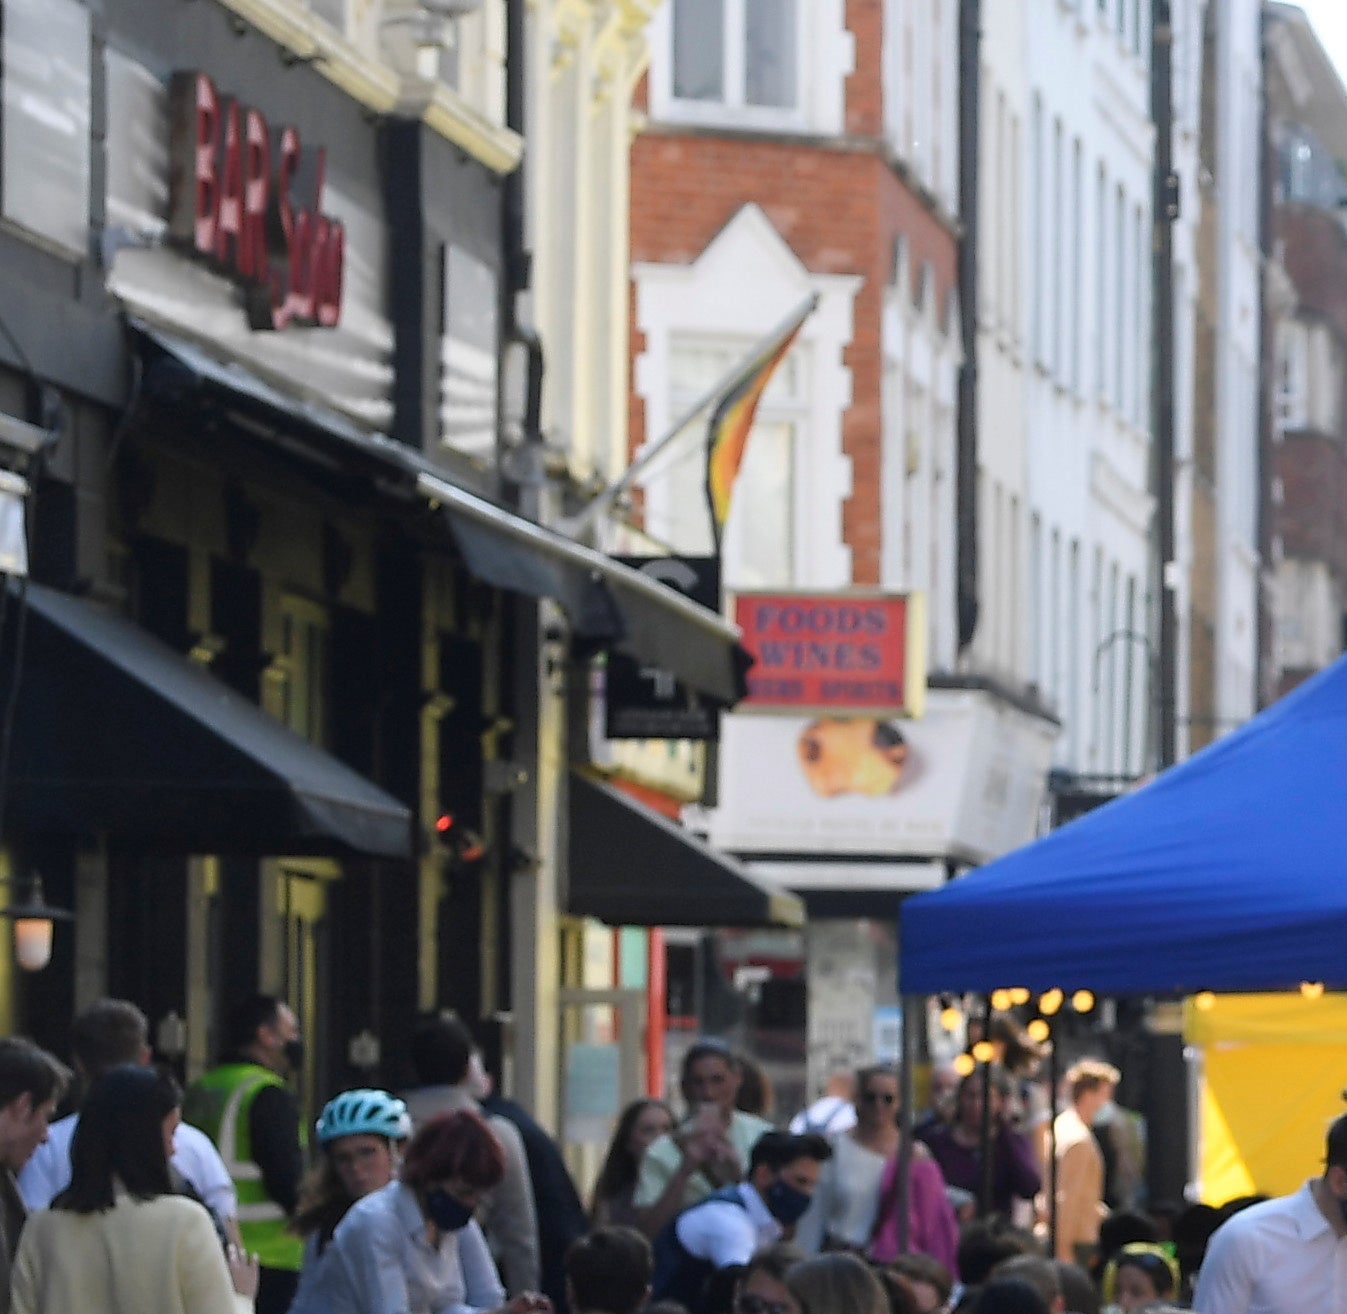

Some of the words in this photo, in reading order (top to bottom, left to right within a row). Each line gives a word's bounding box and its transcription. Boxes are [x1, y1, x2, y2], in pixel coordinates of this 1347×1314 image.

[195, 73, 269, 284] BAR
[756, 605, 887, 636] FOODS
[760, 640, 883, 672] WINES
